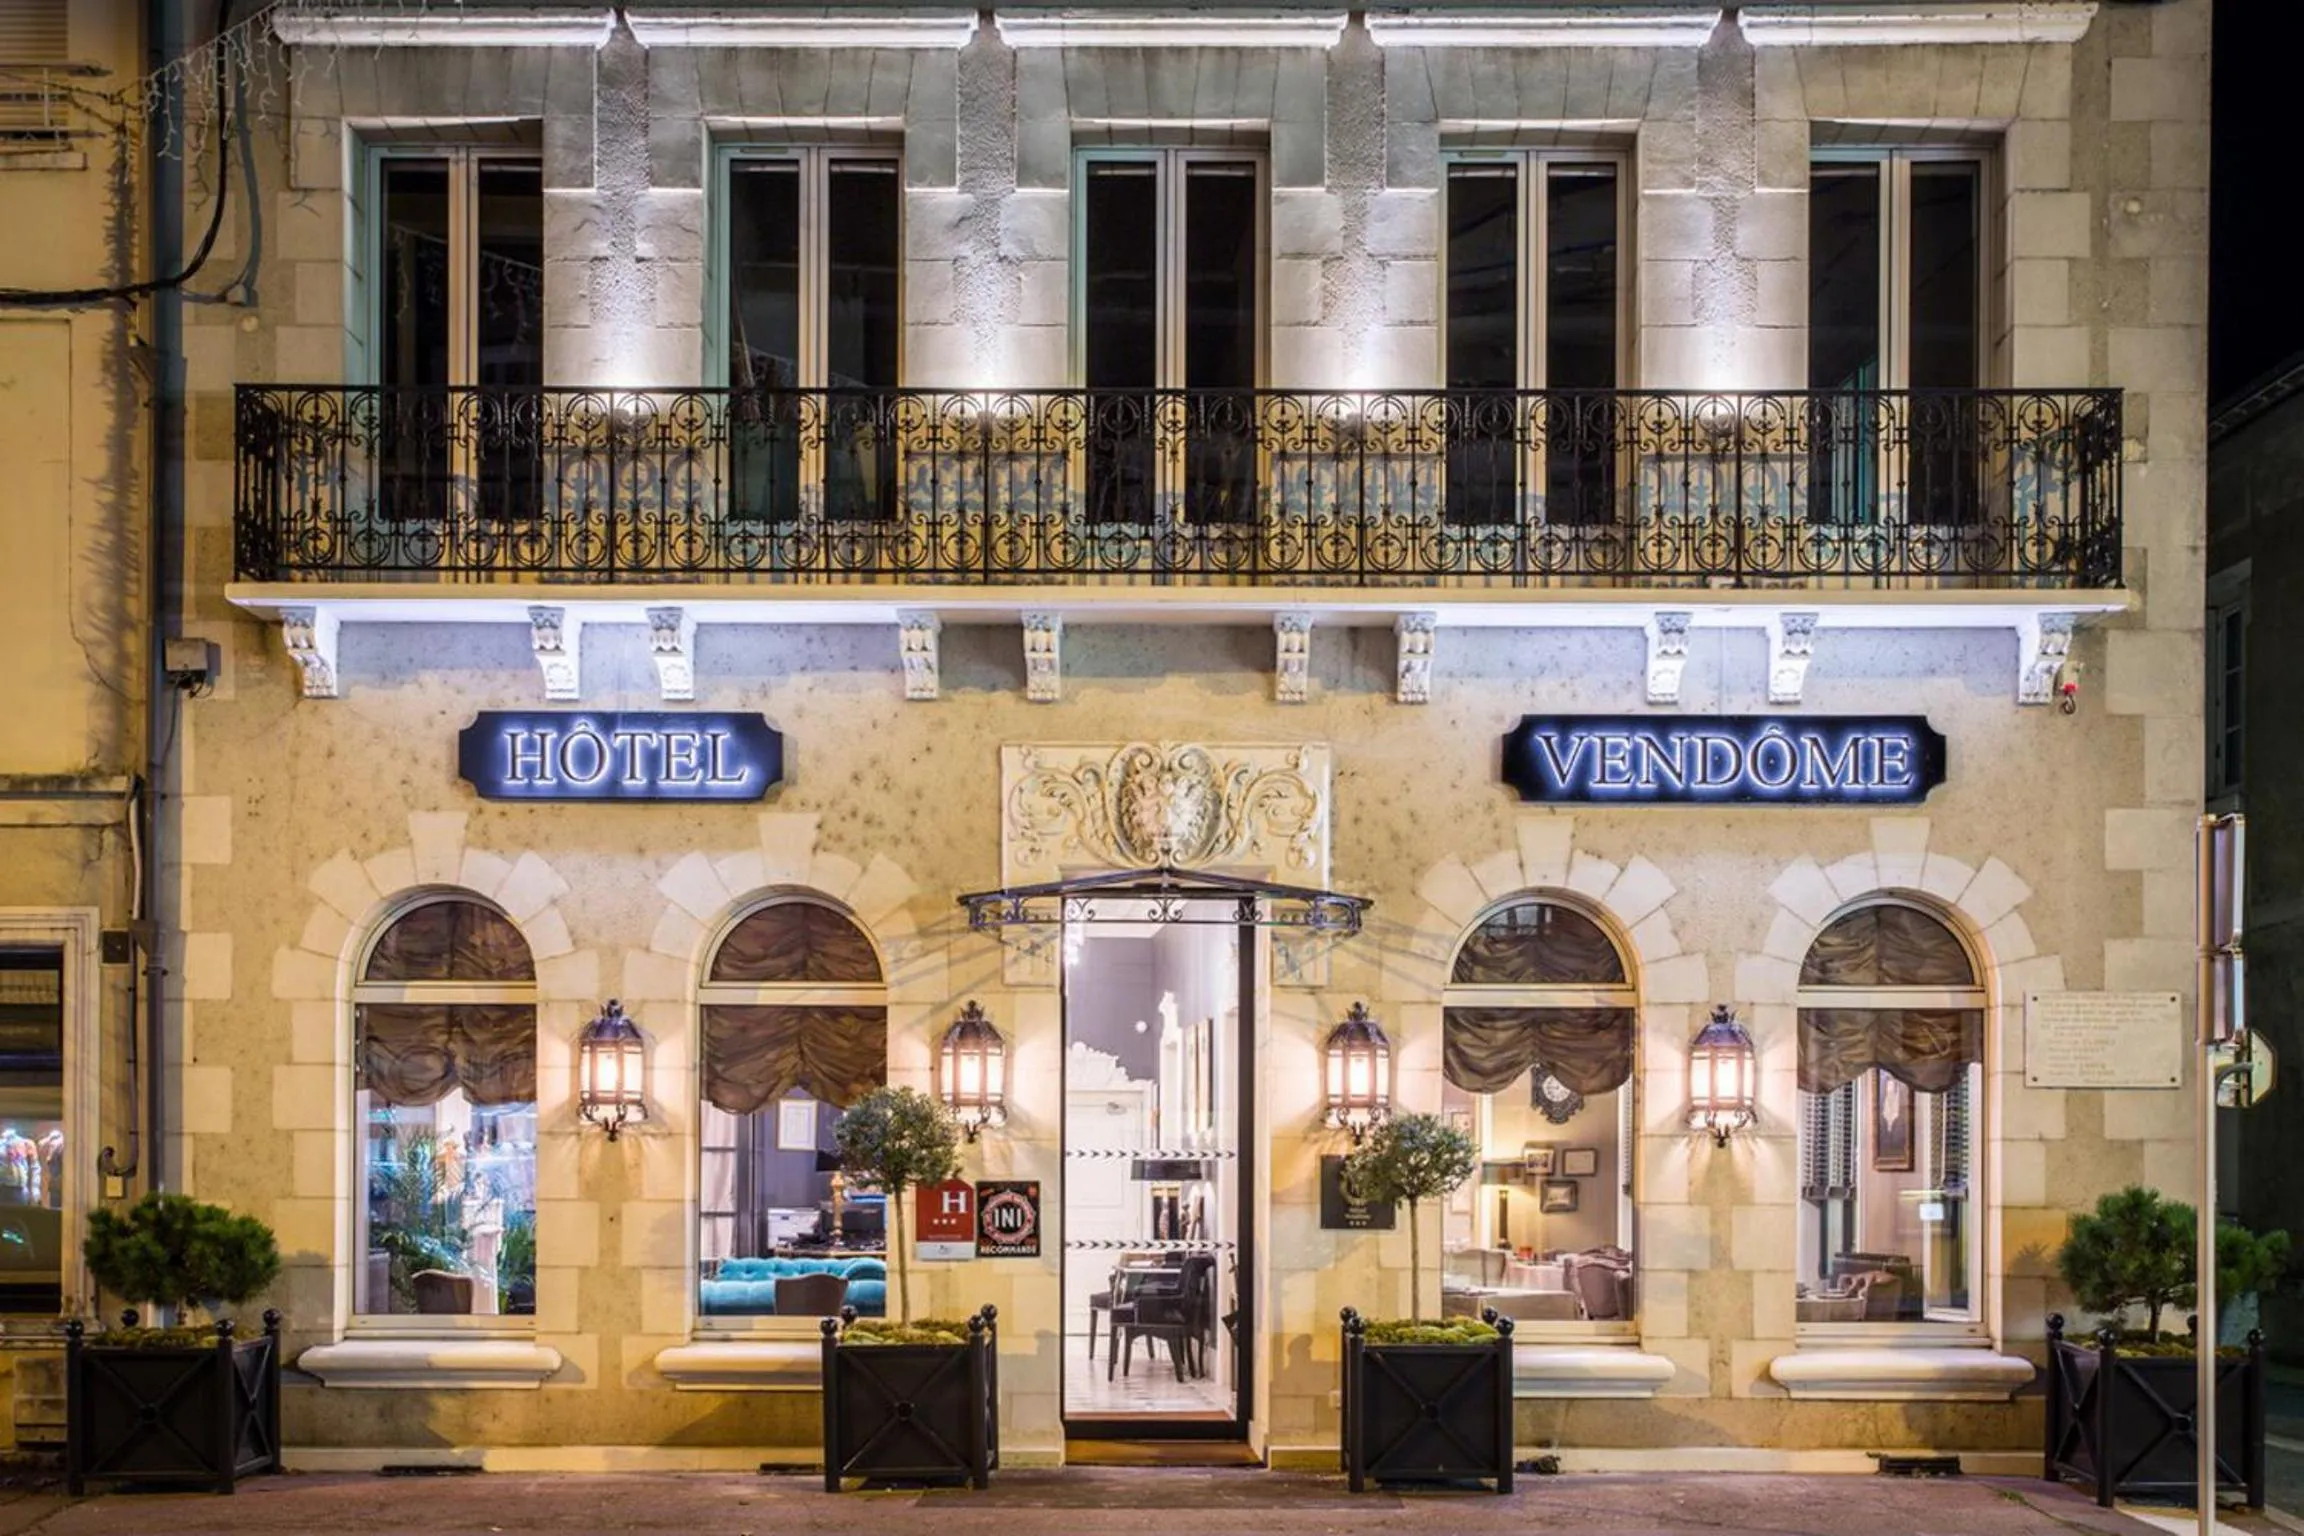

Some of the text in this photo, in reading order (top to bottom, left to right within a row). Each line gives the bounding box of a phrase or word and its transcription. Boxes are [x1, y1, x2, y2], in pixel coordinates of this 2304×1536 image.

[504, 720, 751, 785] HÔTEL
[1536, 723, 1916, 789] VENDÔME
[942, 1191, 967, 1214] H
